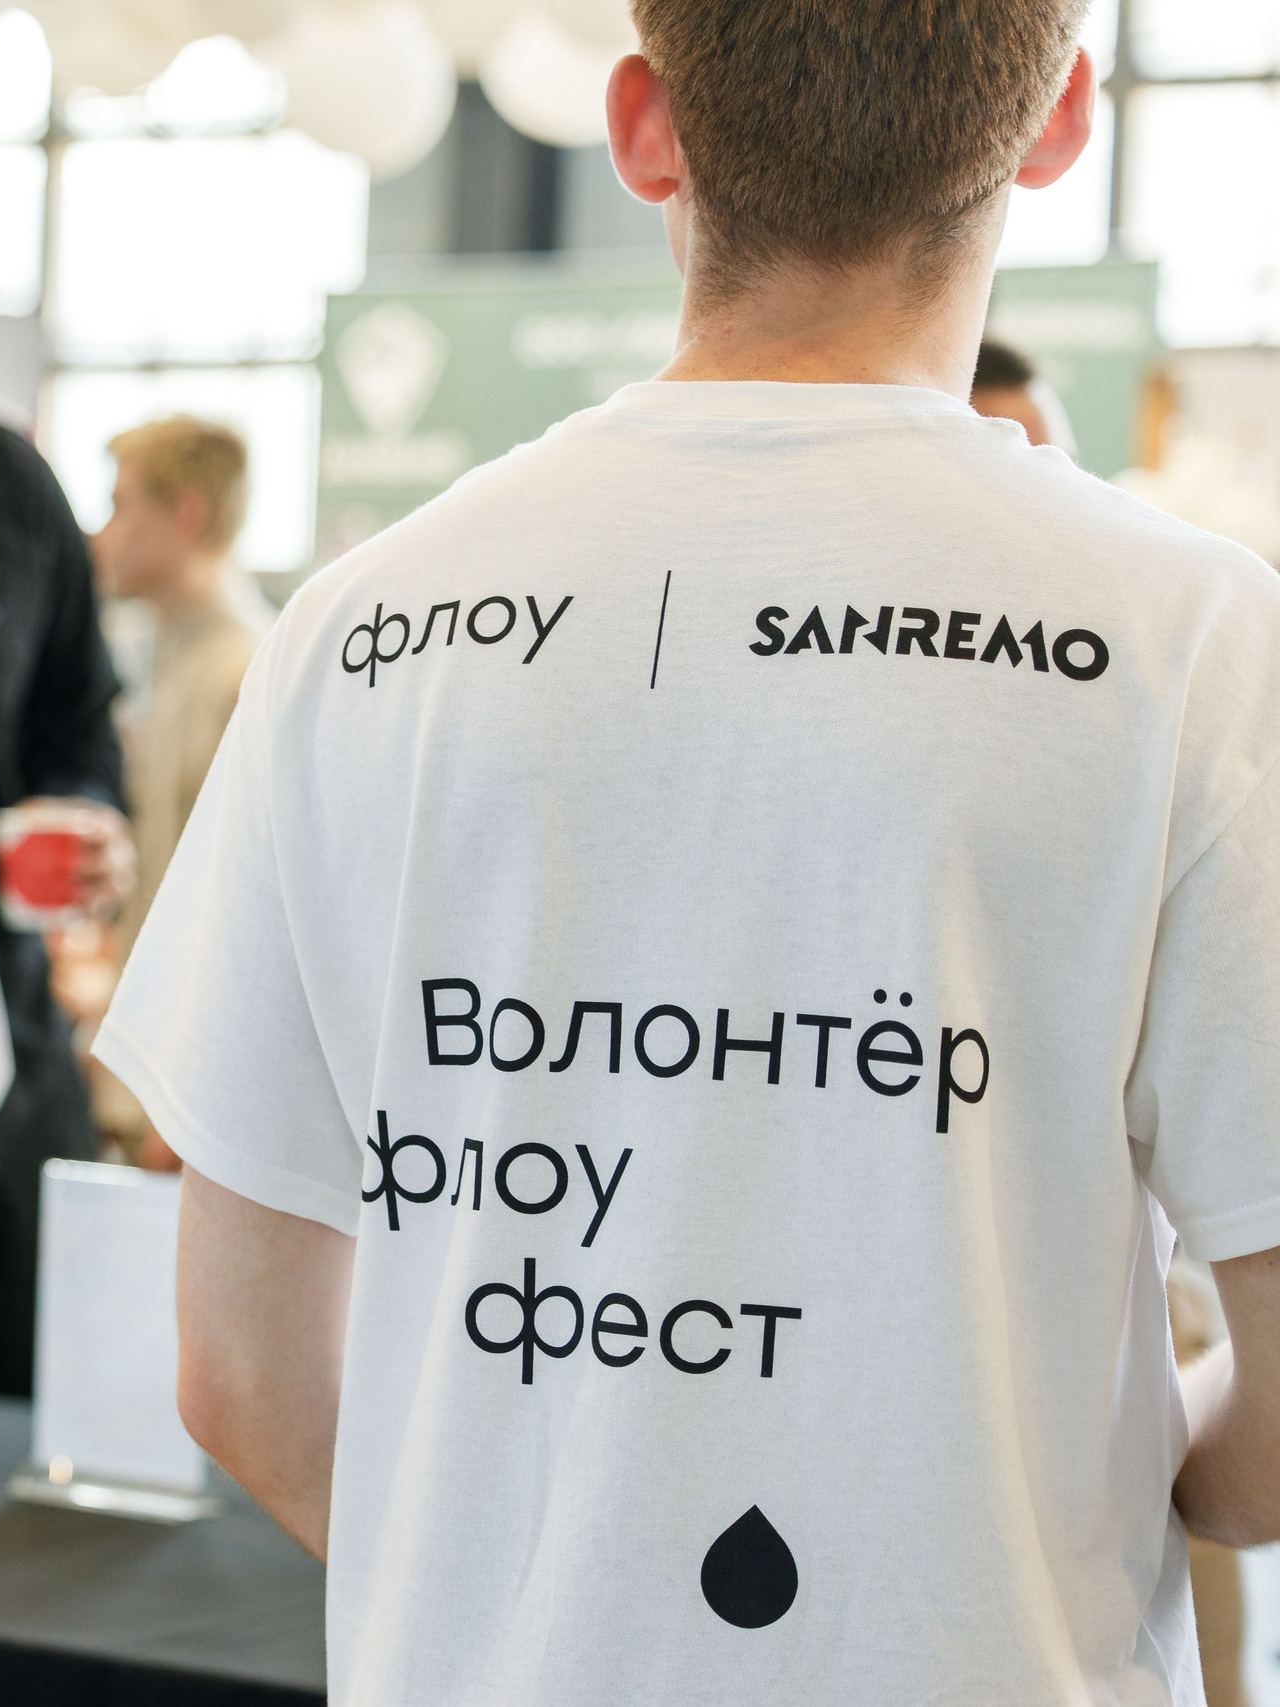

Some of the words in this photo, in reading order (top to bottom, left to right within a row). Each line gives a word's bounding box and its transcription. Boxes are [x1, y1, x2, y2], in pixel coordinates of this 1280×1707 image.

[341, 595, 575, 688] флоу
[748, 604, 1110, 682] SANREMO
[421, 977, 990, 1134] Волонтёр
[361, 1109, 634, 1248] флоу
[464, 1257, 803, 1386] фест
